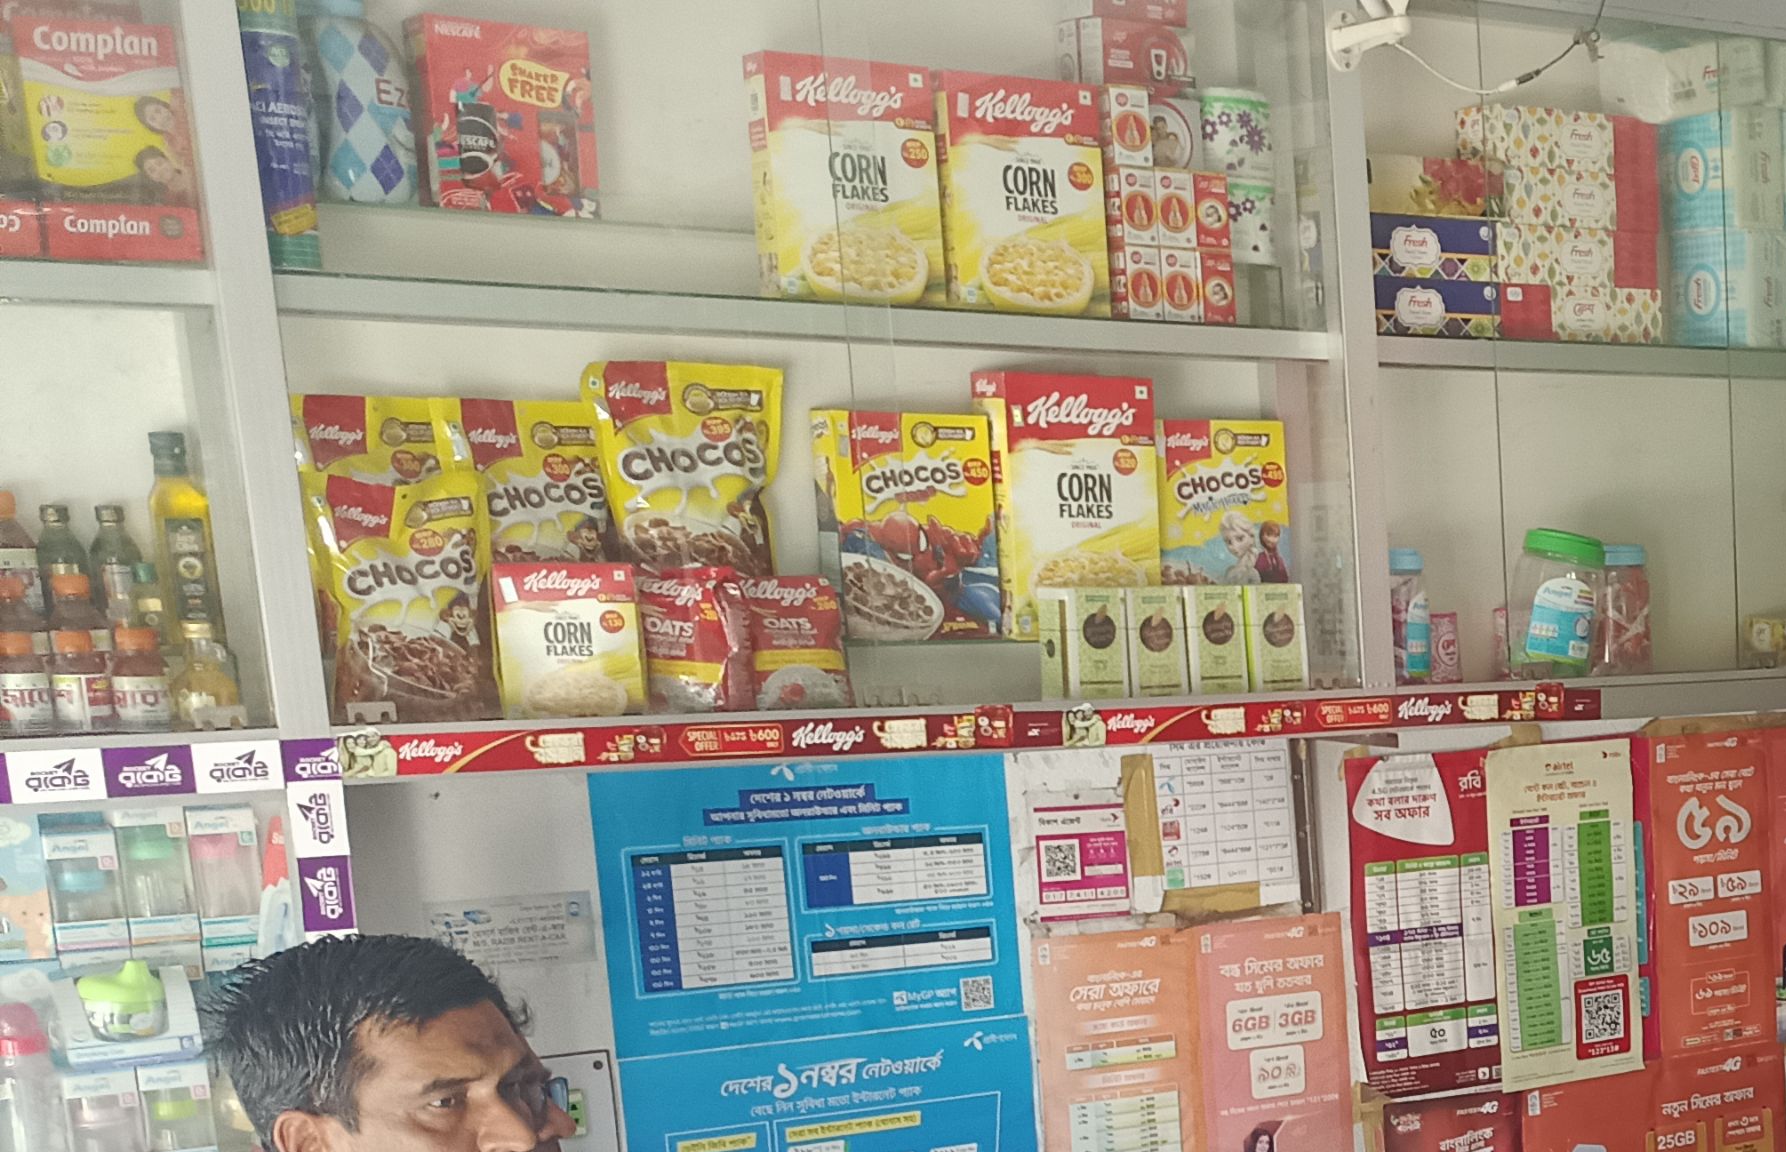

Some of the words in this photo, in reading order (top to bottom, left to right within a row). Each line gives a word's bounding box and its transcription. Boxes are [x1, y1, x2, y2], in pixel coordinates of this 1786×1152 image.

[33, 26, 158, 58] Complan
[510, 63, 558, 84] SHAKER
[508, 78, 558, 103] FREE
[795, 73, 903, 117] Kellogg's
[976, 89, 1075, 133] Kellogg's
[1570, 128, 1593, 142] Fresh
[829, 152, 887, 186] CORN
[1002, 164, 1056, 199] CORN
[832, 183, 890, 203] FLAKES
[1572, 188, 1596, 201] Fresh
[1006, 195, 1058, 216] FLAKES
[64, 214, 150, 237] Complan
[1403, 234, 1428, 249] Fresh
[1570, 245, 1594, 259] Fresh
[1407, 295, 1432, 310] Fresh
[608, 381, 666, 405] Kellogg's
[1027, 392, 1136, 436] Kellogg's
[310, 425, 363, 442] Kellogg's
[469, 428, 518, 447] Kellogg's
[851, 423, 899, 442] Kellogg's
[1167, 433, 1209, 451] Kellogg's
[622, 438, 761, 482] CHOCOS
[866, 461, 961, 494] CHOCOS
[1057, 473, 1112, 503] CORN
[1177, 468, 1261, 500] CHOCOS
[488, 476, 604, 517] CHOCOS
[334, 506, 389, 527] Kellogg's
[1059, 503, 1113, 520] FLAKES
[347, 549, 474, 595] CHOCOS
[523, 568, 602, 596] Kellogg's
[544, 621, 592, 645] CORN
[647, 617, 694, 636] OATS
[762, 617, 812, 631] OATS
[546, 644, 594, 657] FLAKES
[1398, 698, 1453, 722] Kellogg's
[1106, 712, 1156, 736] Kellogg's
[687, 730, 717, 742] SPECIAL
[694, 741, 720, 752] OFFER
[792, 724, 865, 750] Kellogg's
[398, 740, 463, 762] Kellogg's
[1458, 770, 1482, 792] রবি
[1374, 810, 1391, 821] সব
[1394, 805, 1430, 820] অফার
[1677, 794, 1751, 850] ৫৯
[1244, 958, 1283, 977] সিমের
[1286, 955, 1324, 970] অফার
[1108, 978, 1160, 1000] অফারে
[1232, 1014, 1271, 1033] 6GB
[1278, 1009, 1317, 1029] 3GB
[721, 1075, 774, 1098] দেশের
[773, 1063, 799, 1099] ১
[797, 1057, 868, 1089] নম্বর
[862, 1049, 945, 1080] নেটওয়ার্কে
[1661, 1100, 1688, 1118] নতুন
[1690, 1093, 1722, 1110] সিমের
[1657, 1130, 1696, 1151] 25GB
